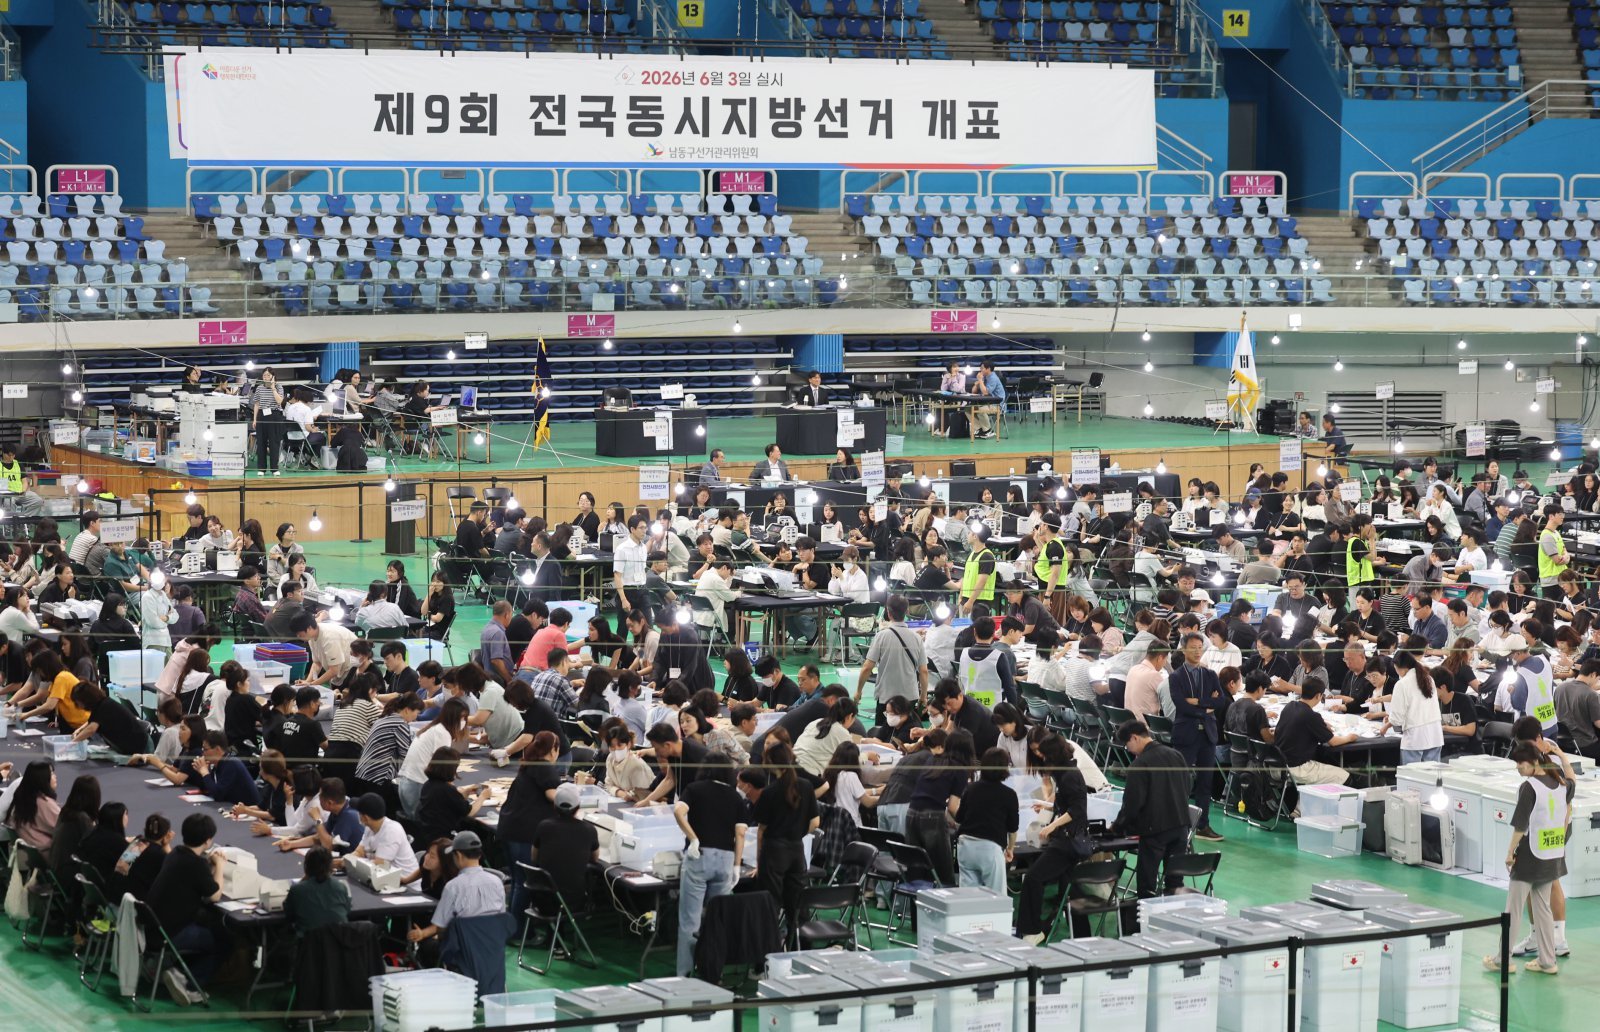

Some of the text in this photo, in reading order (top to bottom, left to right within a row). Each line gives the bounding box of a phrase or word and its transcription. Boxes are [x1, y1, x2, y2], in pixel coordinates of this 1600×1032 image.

[683, 3, 699, 17] 13
[1228, 13, 1244, 27] 14
[641, 70, 783, 87] 2026년 6월 3일 실시
[373, 92, 1000, 140] 제9회 전국동시지방선거 개표
[669, 147, 759, 159] 남동구선거관리위원회
[75, 170, 88, 182] L1
[734, 172, 750, 183] M1
[1245, 176, 1259, 186] N1
[586, 315, 596, 326] M
[950, 310, 958, 321] N
[219, 321, 227, 333] L
